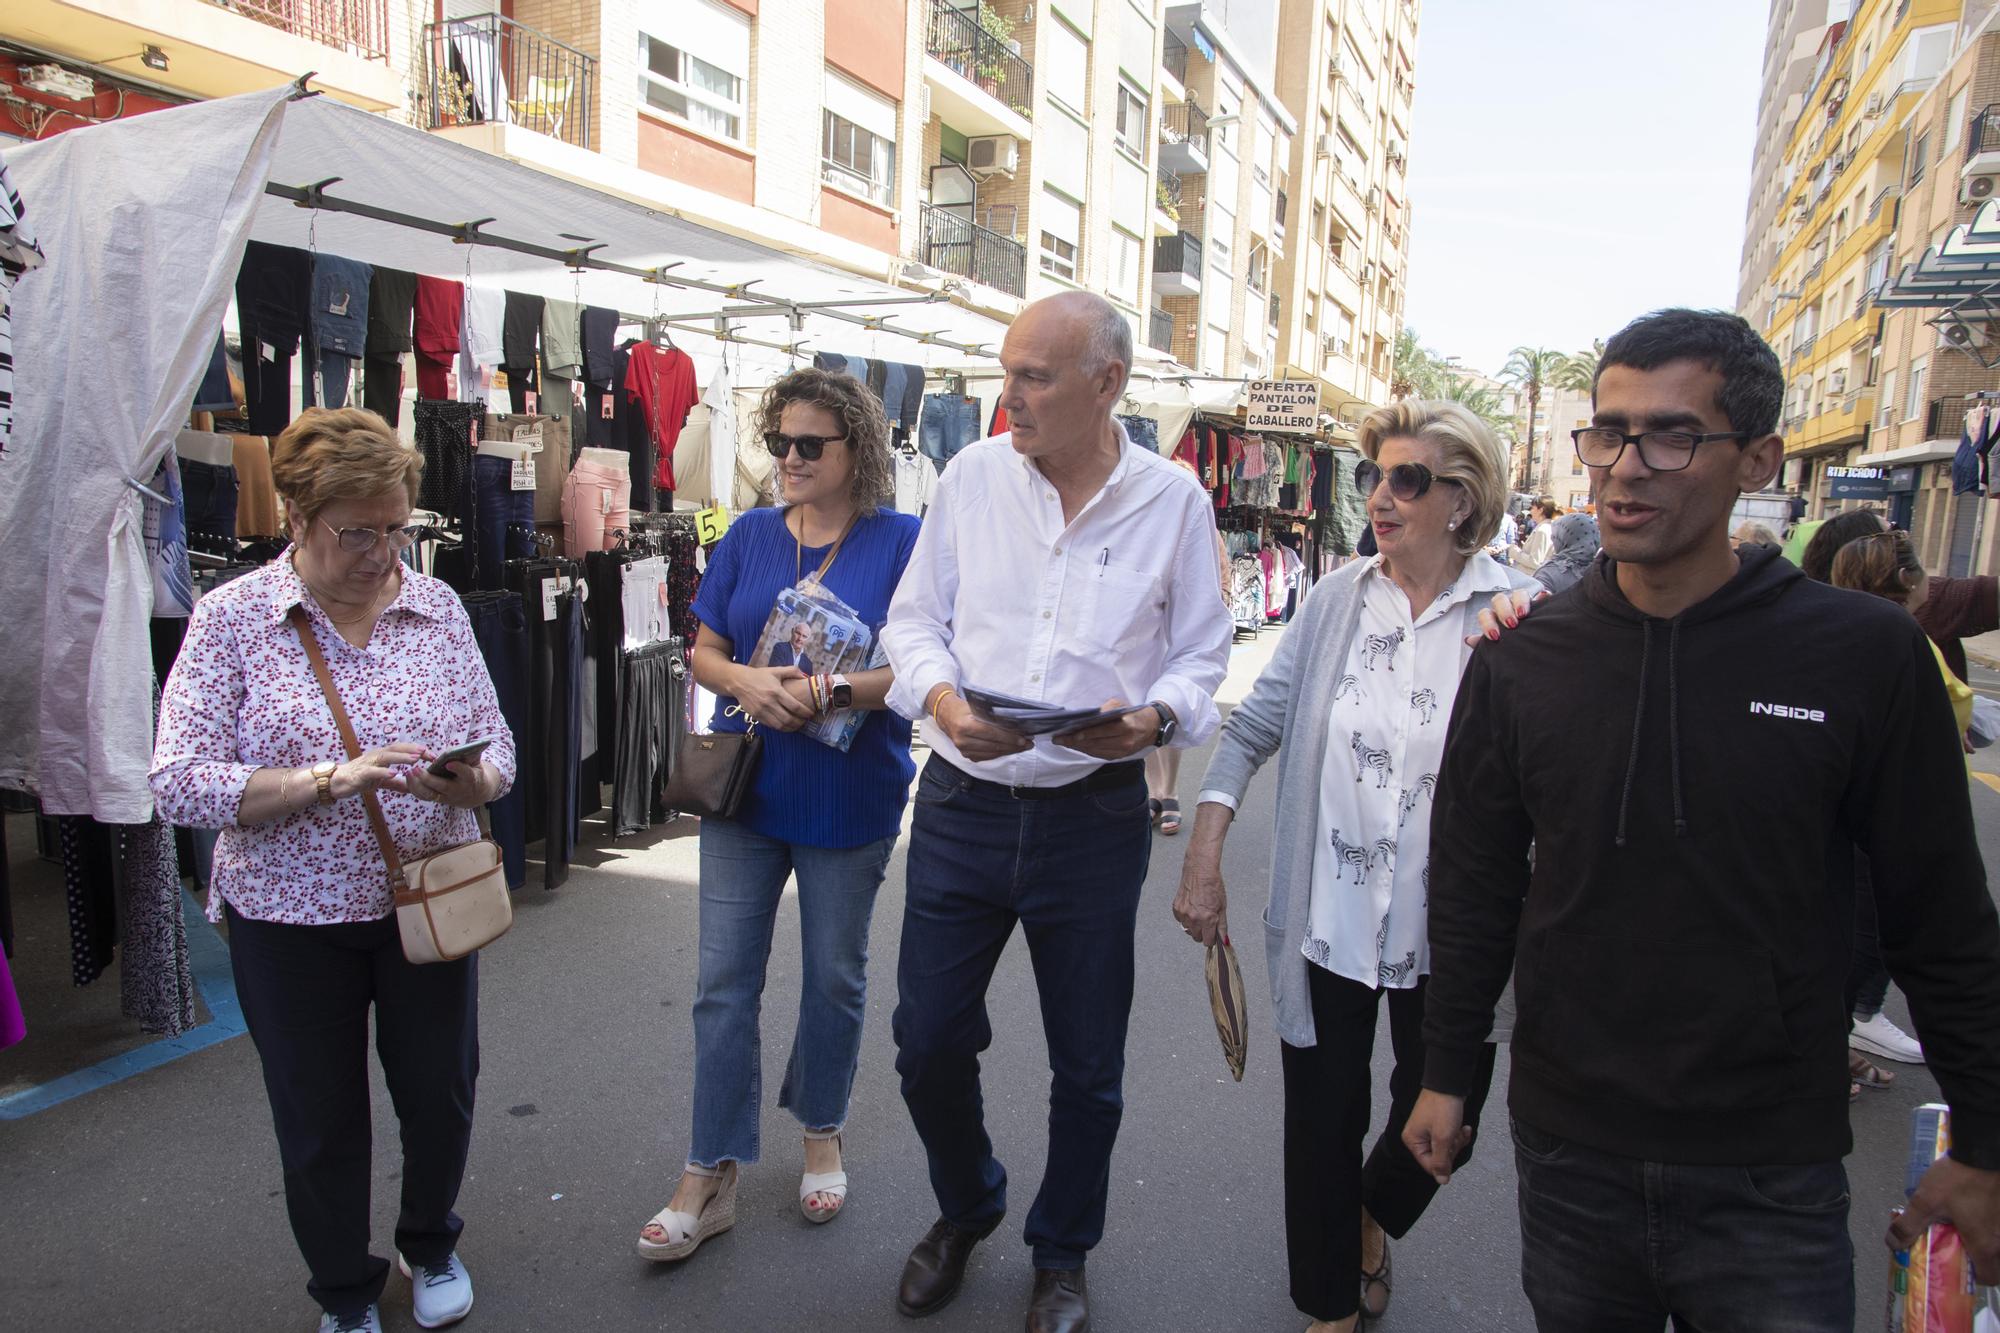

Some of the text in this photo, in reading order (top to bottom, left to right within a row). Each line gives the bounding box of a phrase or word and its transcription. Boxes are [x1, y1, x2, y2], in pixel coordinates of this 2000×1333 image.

[1251, 382, 1316, 393] OFERTA
[1250, 393, 1316, 405] PANTALON
[1266, 405, 1294, 413] DE
[1249, 414, 1313, 427] CABALLERO
[1826, 466, 1877, 479] RTIFICADO
[702, 513, 717, 543] 5
